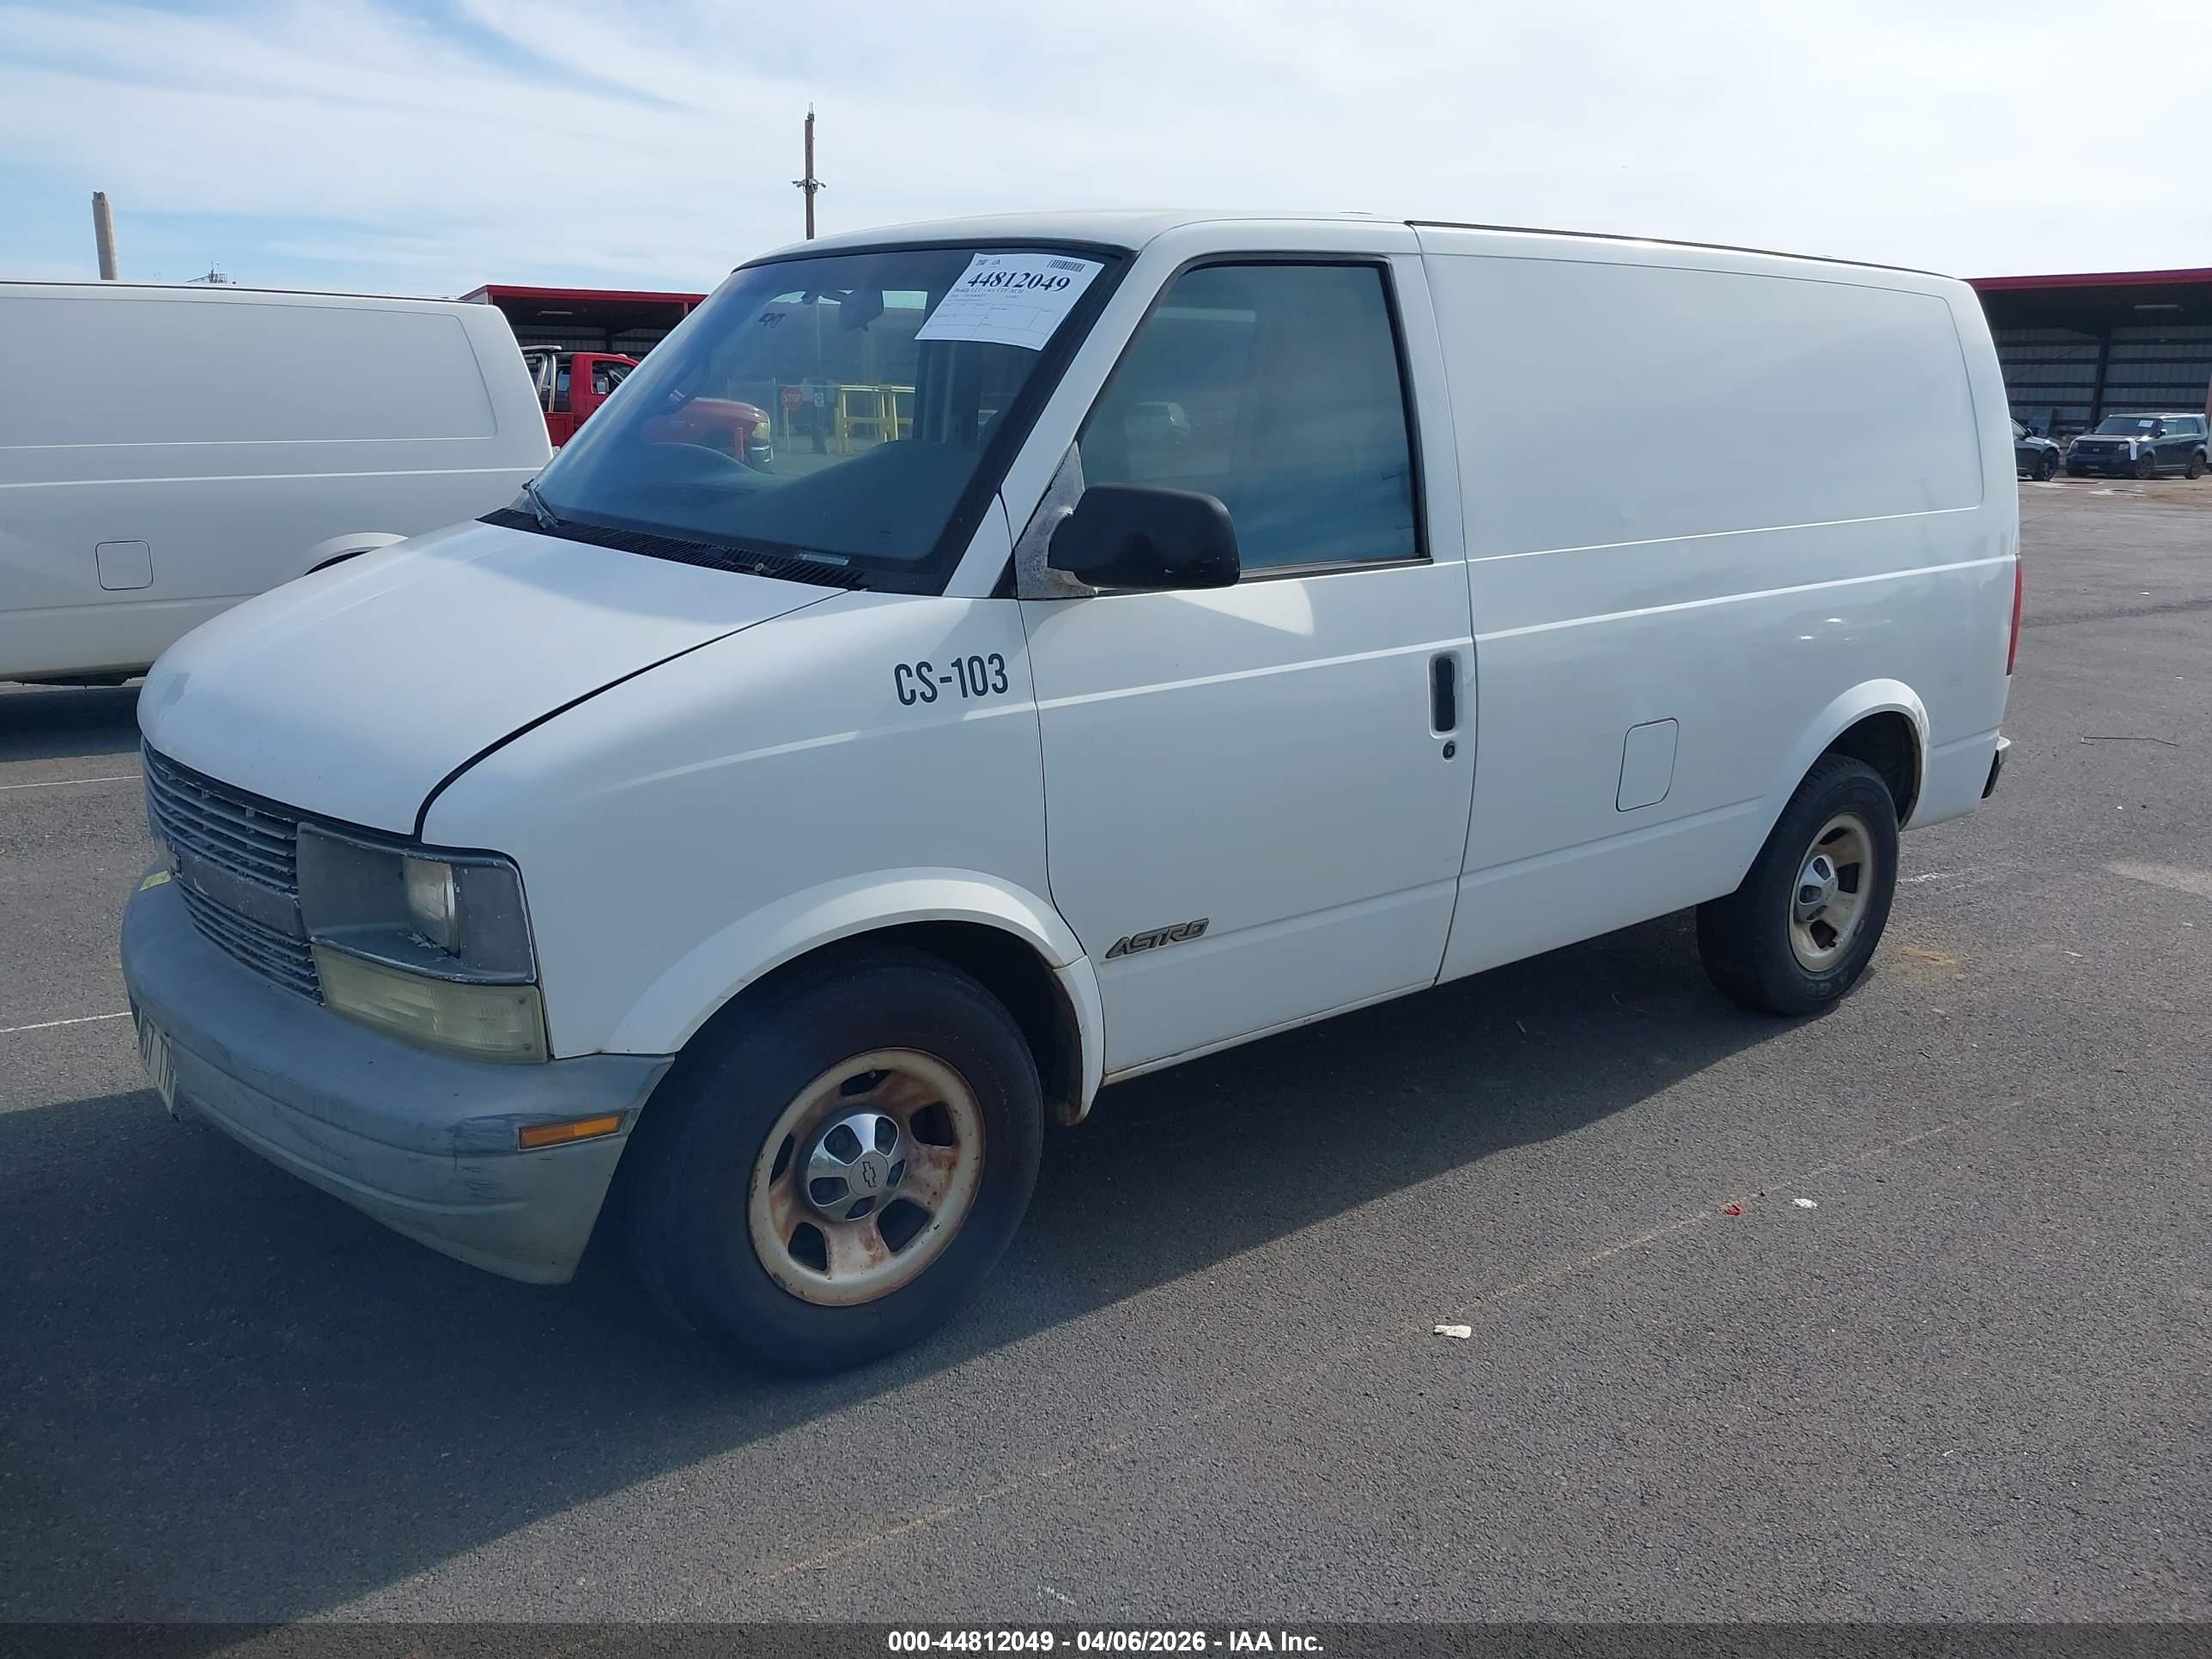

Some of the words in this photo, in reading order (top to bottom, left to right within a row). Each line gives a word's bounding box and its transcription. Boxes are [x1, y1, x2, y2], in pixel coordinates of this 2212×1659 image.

[967, 270, 1072, 293] 44812049
[894, 653, 1008, 706] CS-103
[1105, 917, 1210, 959] ASTRO
